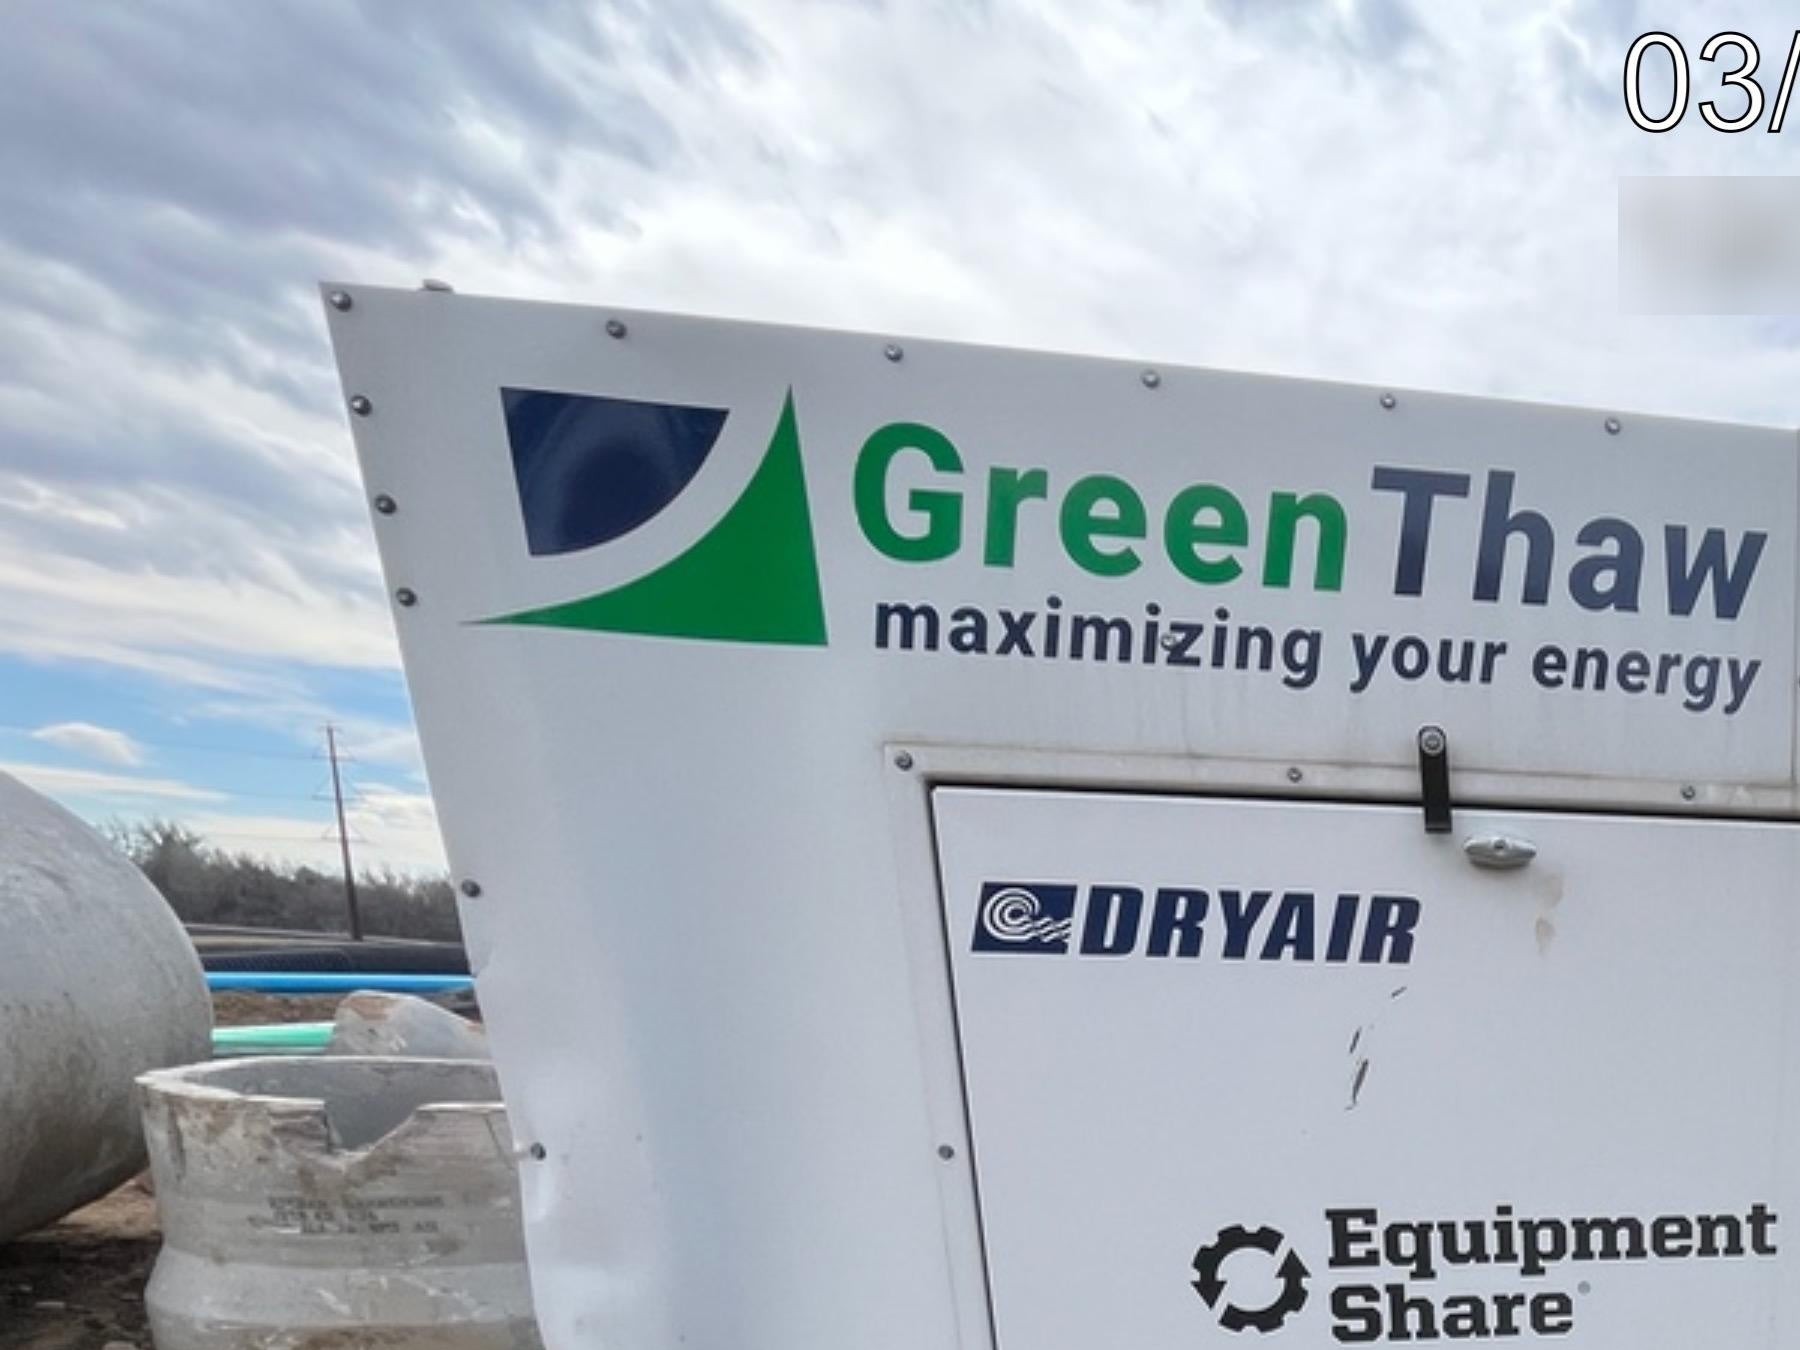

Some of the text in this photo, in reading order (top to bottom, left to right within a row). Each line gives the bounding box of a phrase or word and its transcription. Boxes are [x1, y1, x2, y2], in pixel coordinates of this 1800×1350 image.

[852, 421, 1769, 621] GreenThaw
[875, 595, 1763, 716] maximizing your energy
[1078, 884, 1421, 965] DRYAIR
[1325, 1204, 1778, 1280] Equipment
[1330, 1283, 1574, 1342] Share
